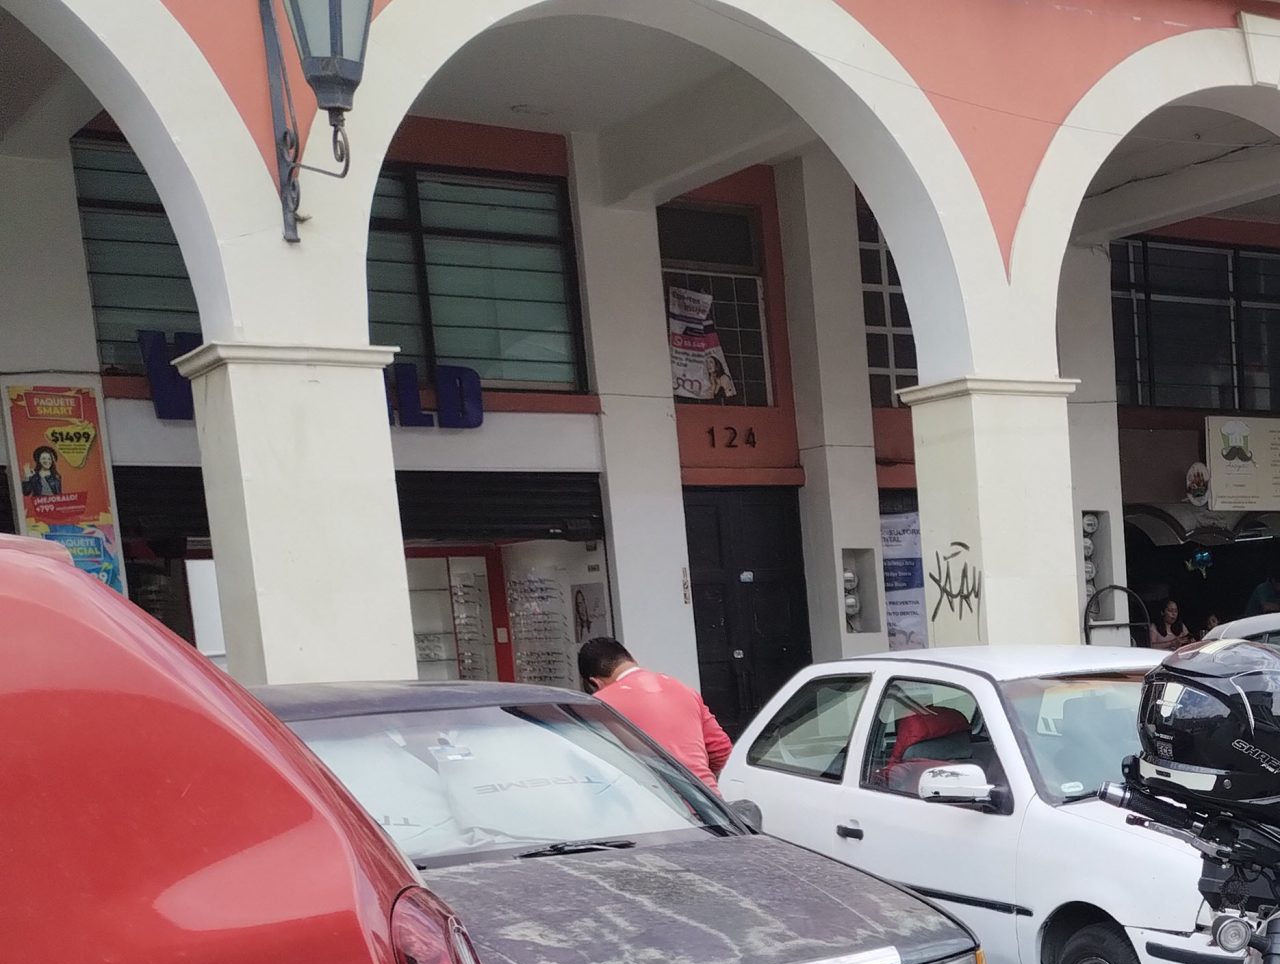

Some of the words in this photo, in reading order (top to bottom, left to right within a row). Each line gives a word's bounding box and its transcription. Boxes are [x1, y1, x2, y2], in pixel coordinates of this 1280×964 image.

[33, 397, 77, 407] PAQUETE
[37, 406, 73, 415] SMART
[51, 430, 91, 443] $1499
[706, 426, 757, 449] 124
[61, 538, 96, 547] AQUETE
